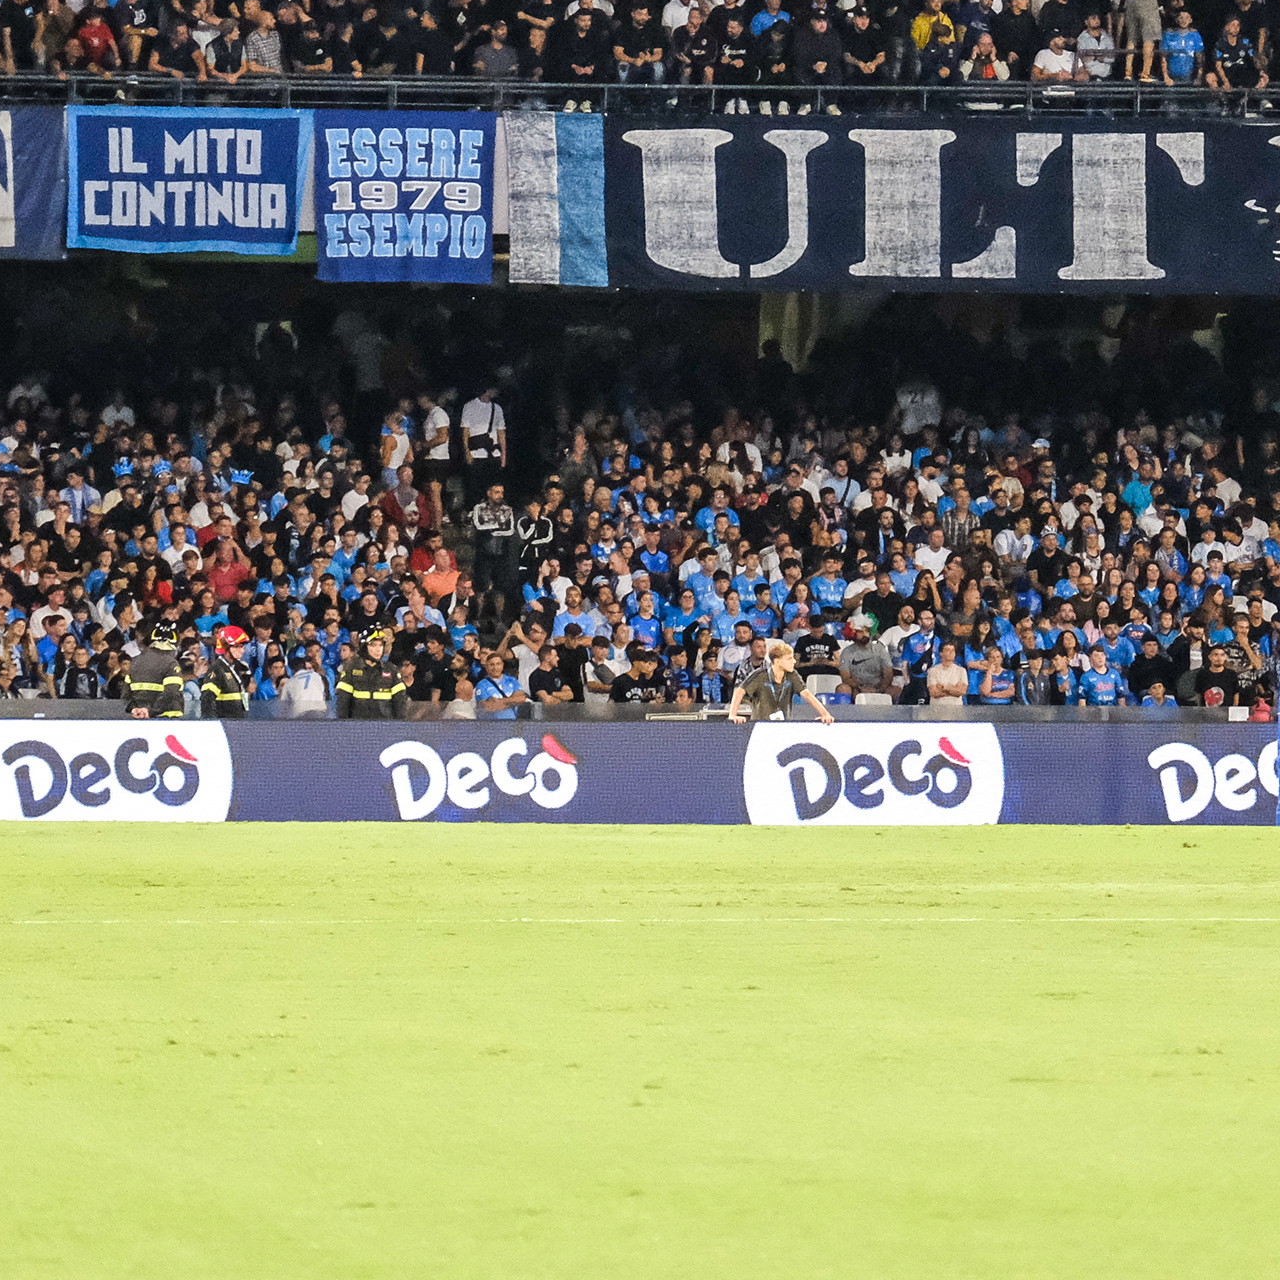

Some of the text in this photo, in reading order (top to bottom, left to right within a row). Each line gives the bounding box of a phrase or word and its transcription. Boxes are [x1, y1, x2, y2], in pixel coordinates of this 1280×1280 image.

[107, 127, 263, 176] IL MITO
[325, 128, 484, 179] ESSERE
[83, 179, 287, 230] CONTINUA
[328, 180, 482, 212] 1979
[325, 213, 487, 259] ESEMPIO
[299, 670, 317, 691] 7
